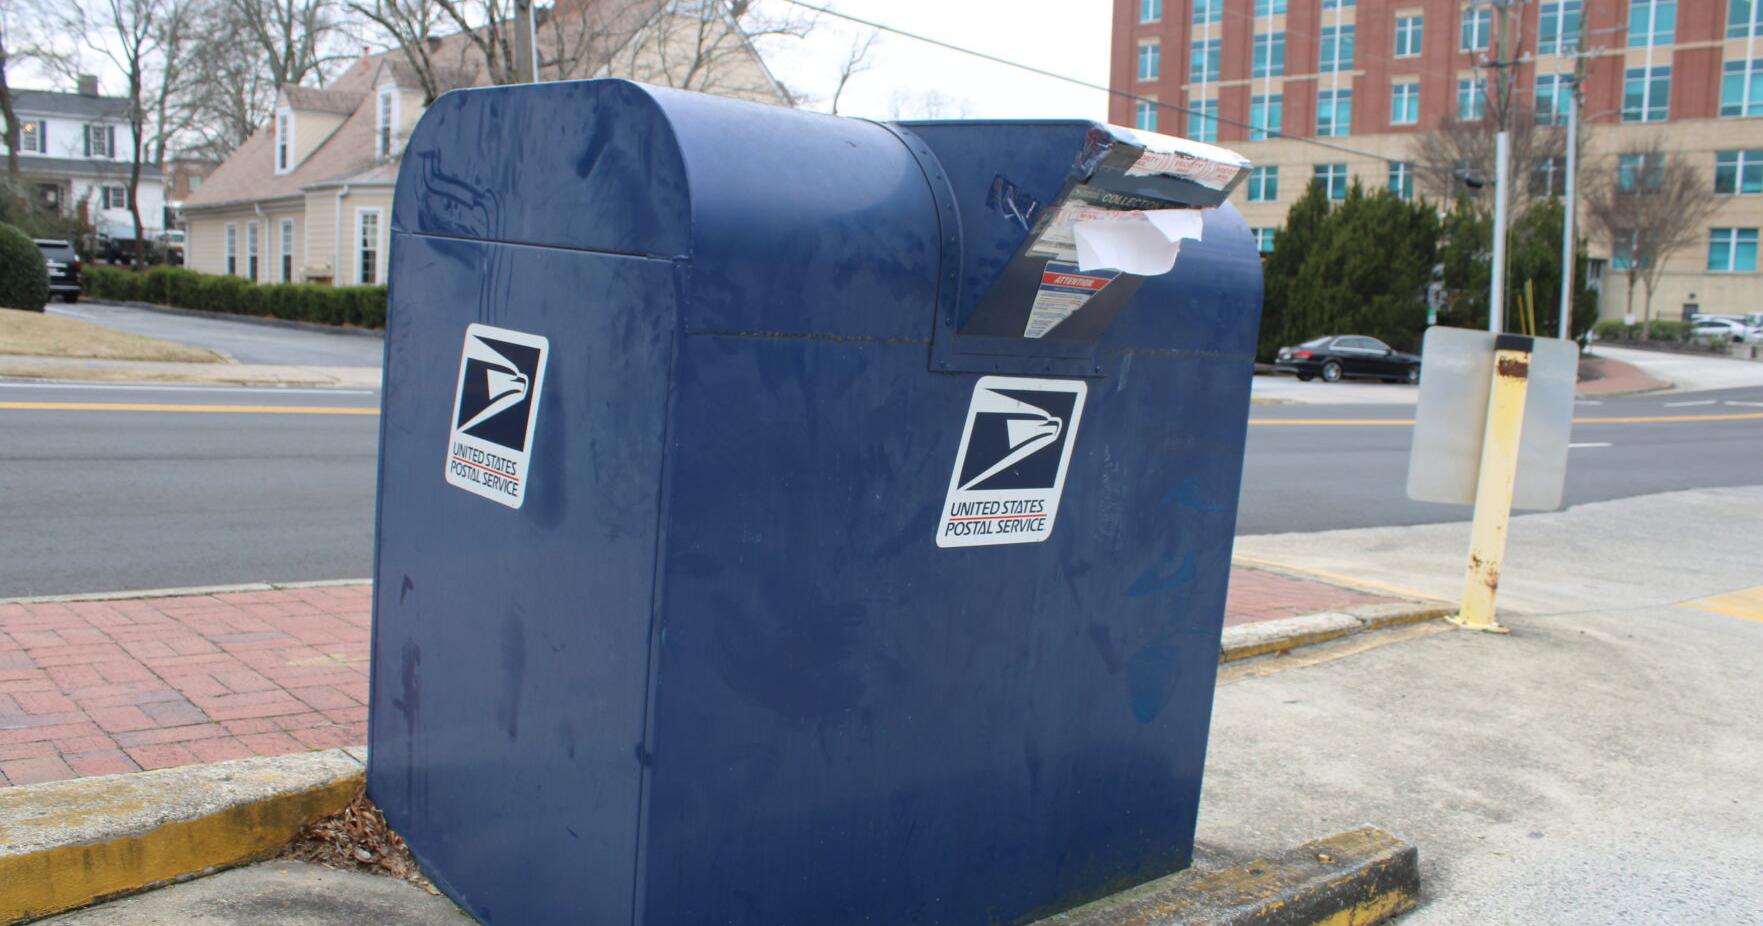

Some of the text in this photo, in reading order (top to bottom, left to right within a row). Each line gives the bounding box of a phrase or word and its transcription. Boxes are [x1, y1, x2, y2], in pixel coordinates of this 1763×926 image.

[1055, 275, 1096, 287] ATTENTION
[453, 441, 517, 476] UNITED STATES
[450, 460, 519, 497] POSTAL SERVICE
[950, 499, 1045, 516] UNITED STATES
[945, 518, 1046, 536] POSTAL SERVICE
